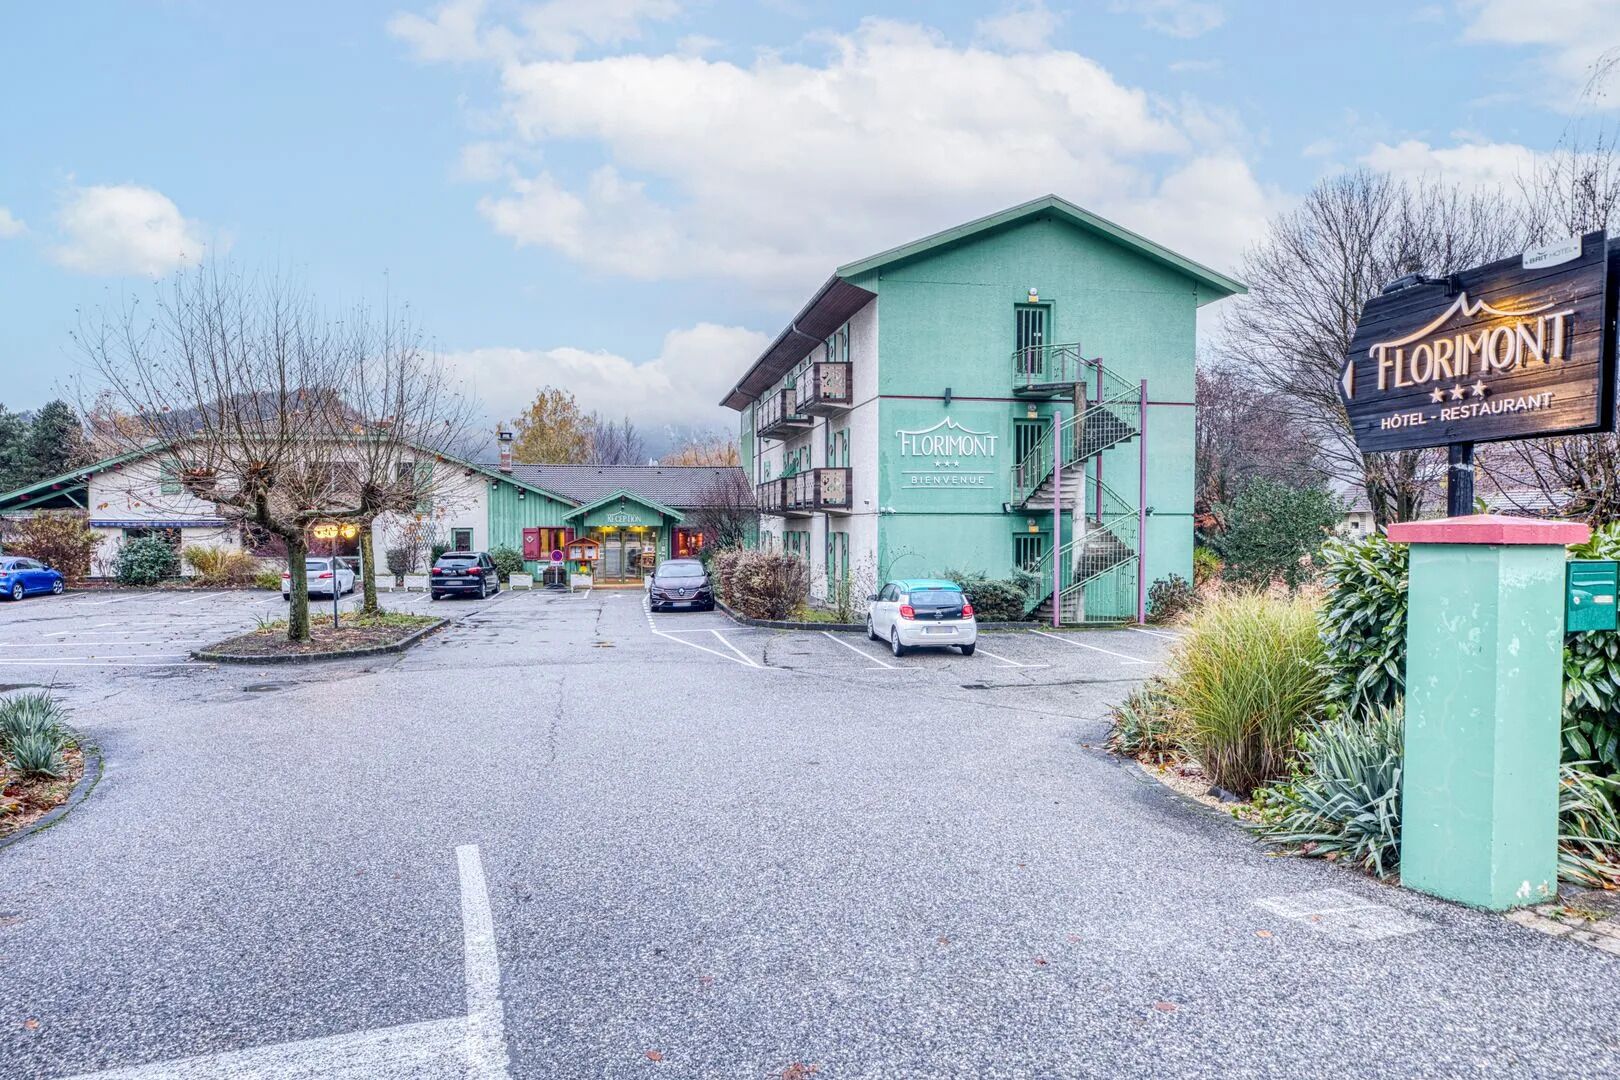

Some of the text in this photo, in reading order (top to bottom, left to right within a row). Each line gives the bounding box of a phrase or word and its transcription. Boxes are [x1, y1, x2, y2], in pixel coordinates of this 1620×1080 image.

[1529, 253, 1548, 264] BRIT
[1370, 306, 1575, 390] FLORIMONT
[1380, 413, 1427, 430] HÔTEL
[1440, 391, 1553, 421] RESTAURANT
[896, 429, 998, 457] FLORIMONT
[911, 476, 985, 484] BIENVENUE
